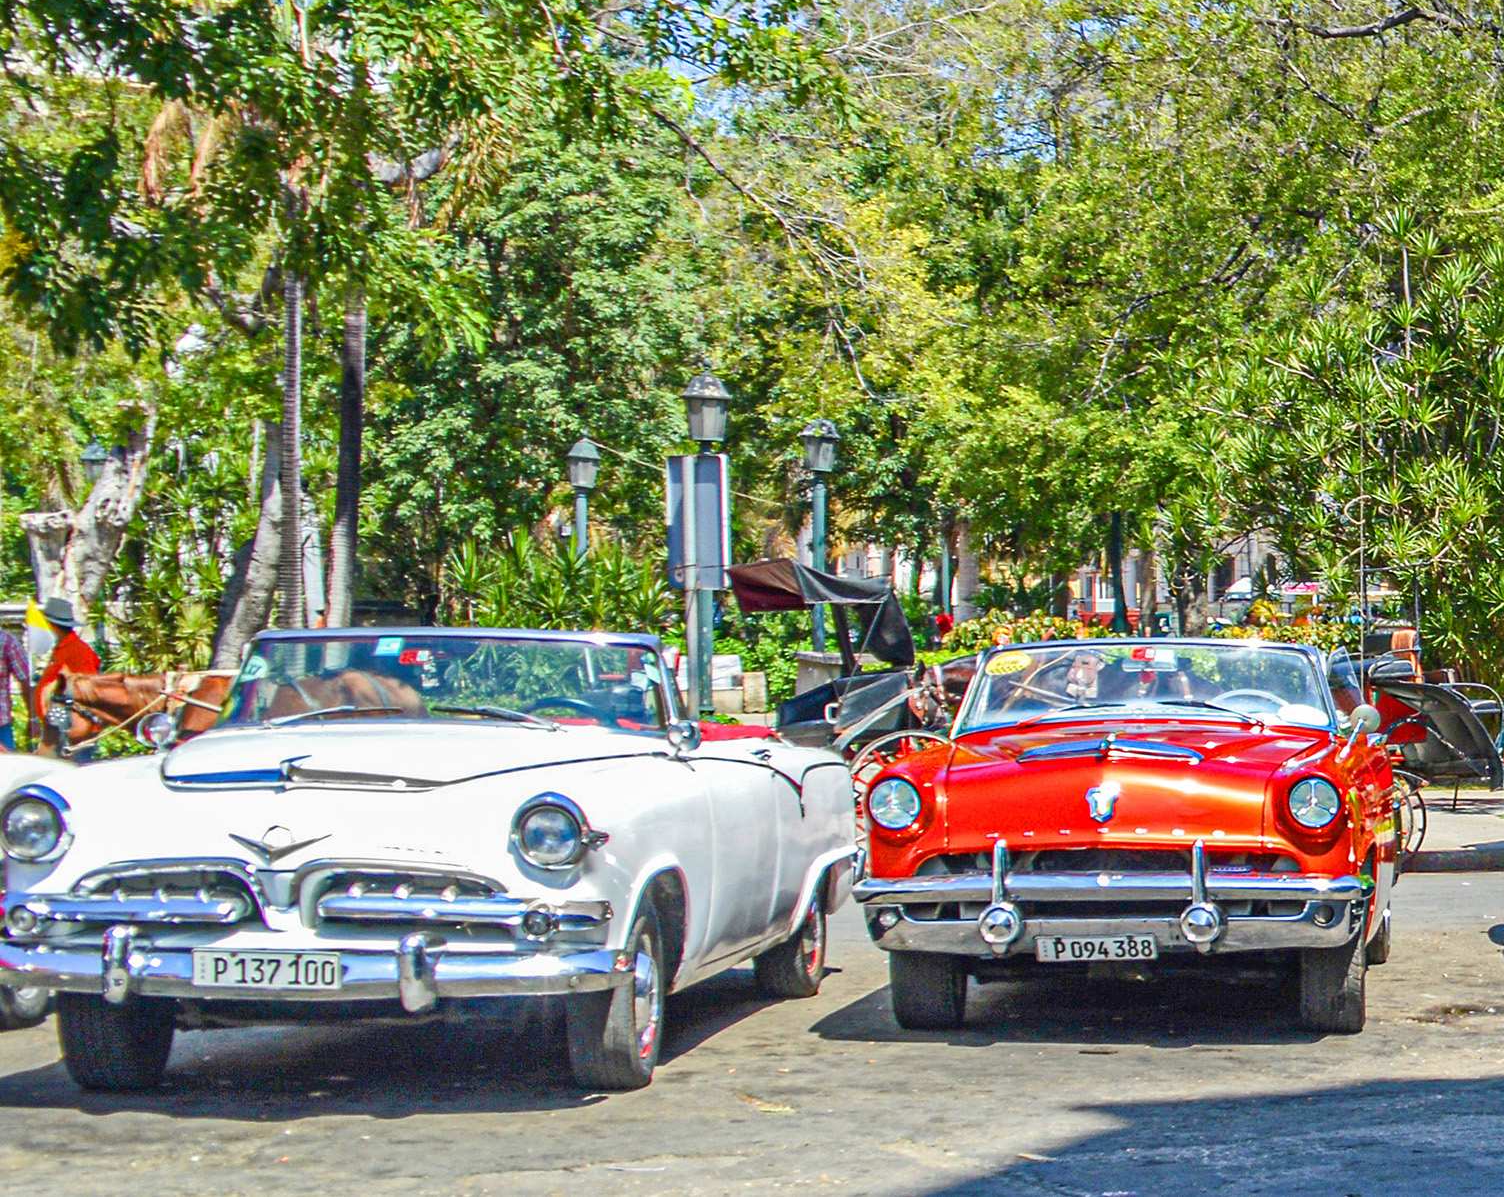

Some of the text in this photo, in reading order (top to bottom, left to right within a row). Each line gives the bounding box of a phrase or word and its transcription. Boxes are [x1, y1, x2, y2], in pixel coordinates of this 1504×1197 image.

[1053, 940, 1066, 960] P
[1070, 941, 1110, 959] 094
[1113, 939, 1153, 958] 388
[213, 957, 336, 986] P 137 100
